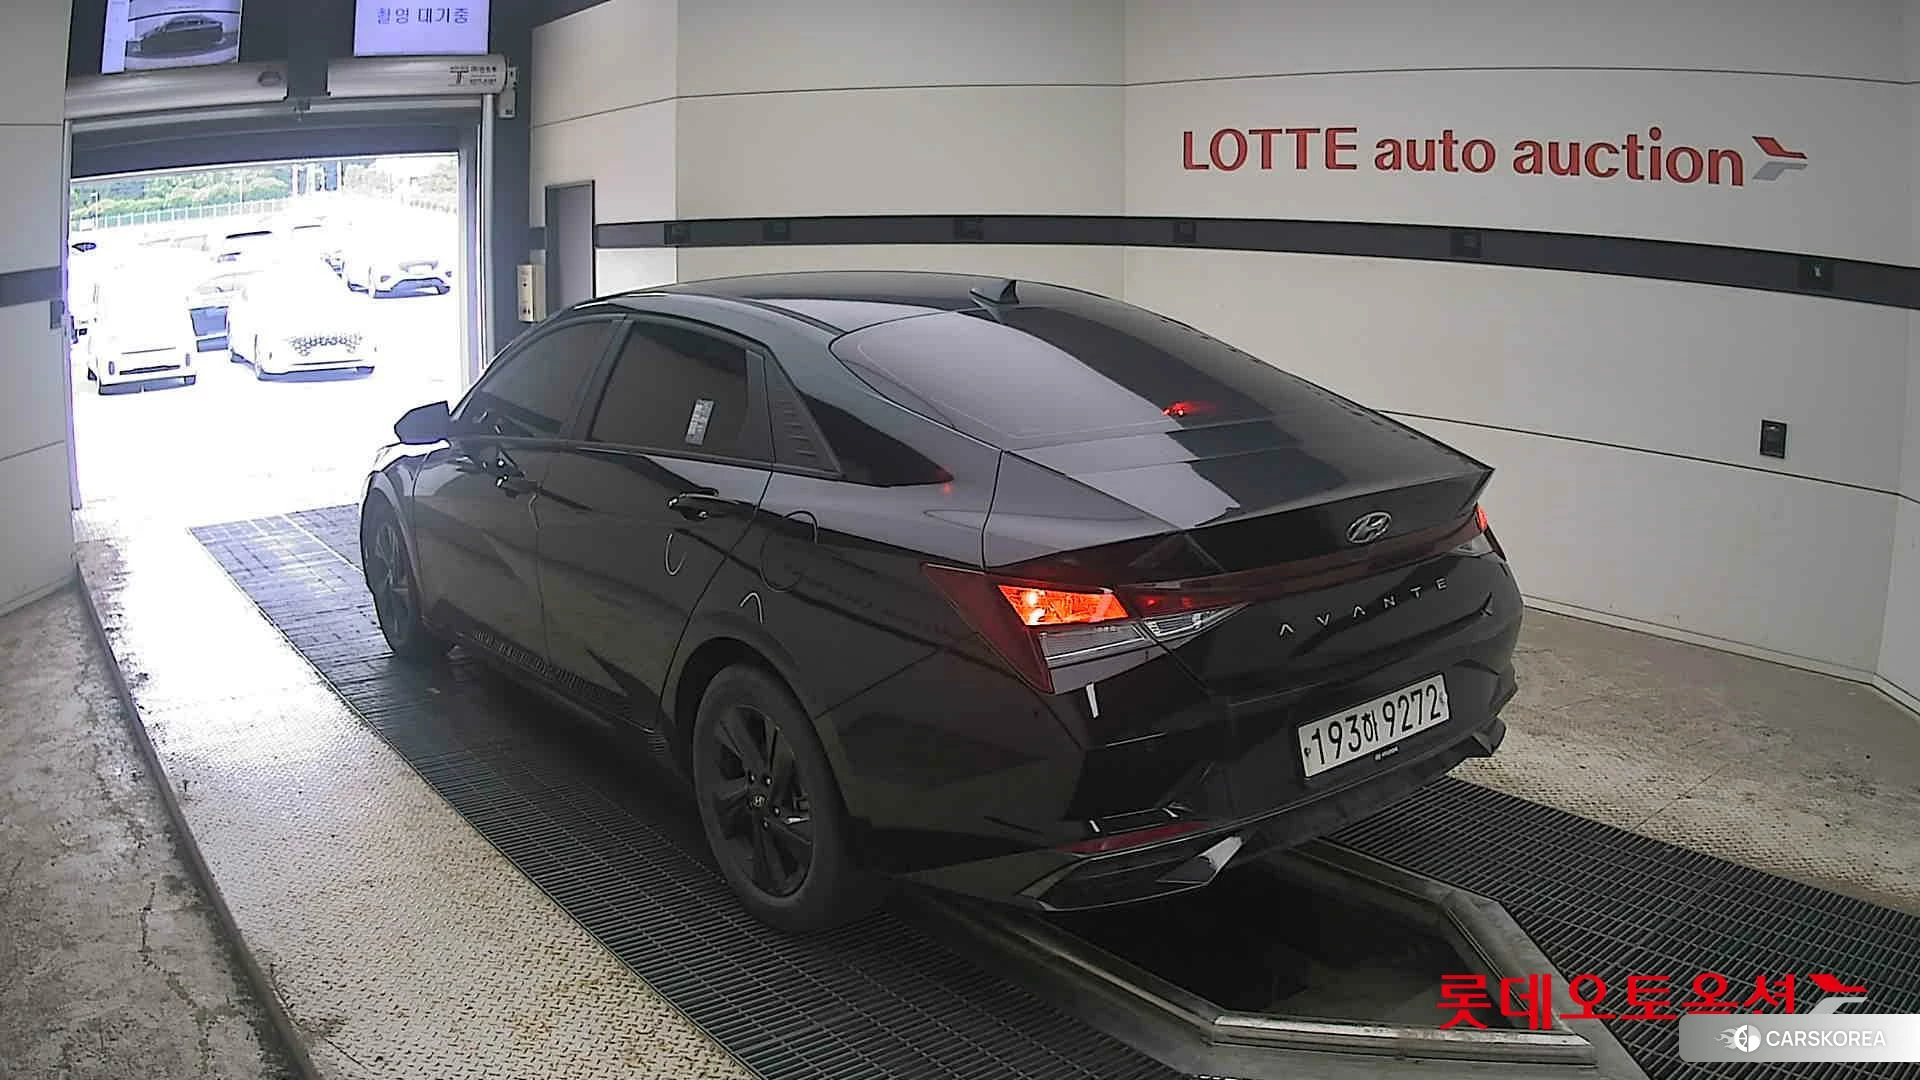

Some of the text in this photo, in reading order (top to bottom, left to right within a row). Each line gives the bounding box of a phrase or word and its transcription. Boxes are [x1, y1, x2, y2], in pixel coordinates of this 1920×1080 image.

[418, 7, 469, 24] 대기중
[1182, 126, 1744, 186] LOTTE auto auction
[1278, 577, 1448, 638] AVANTE
